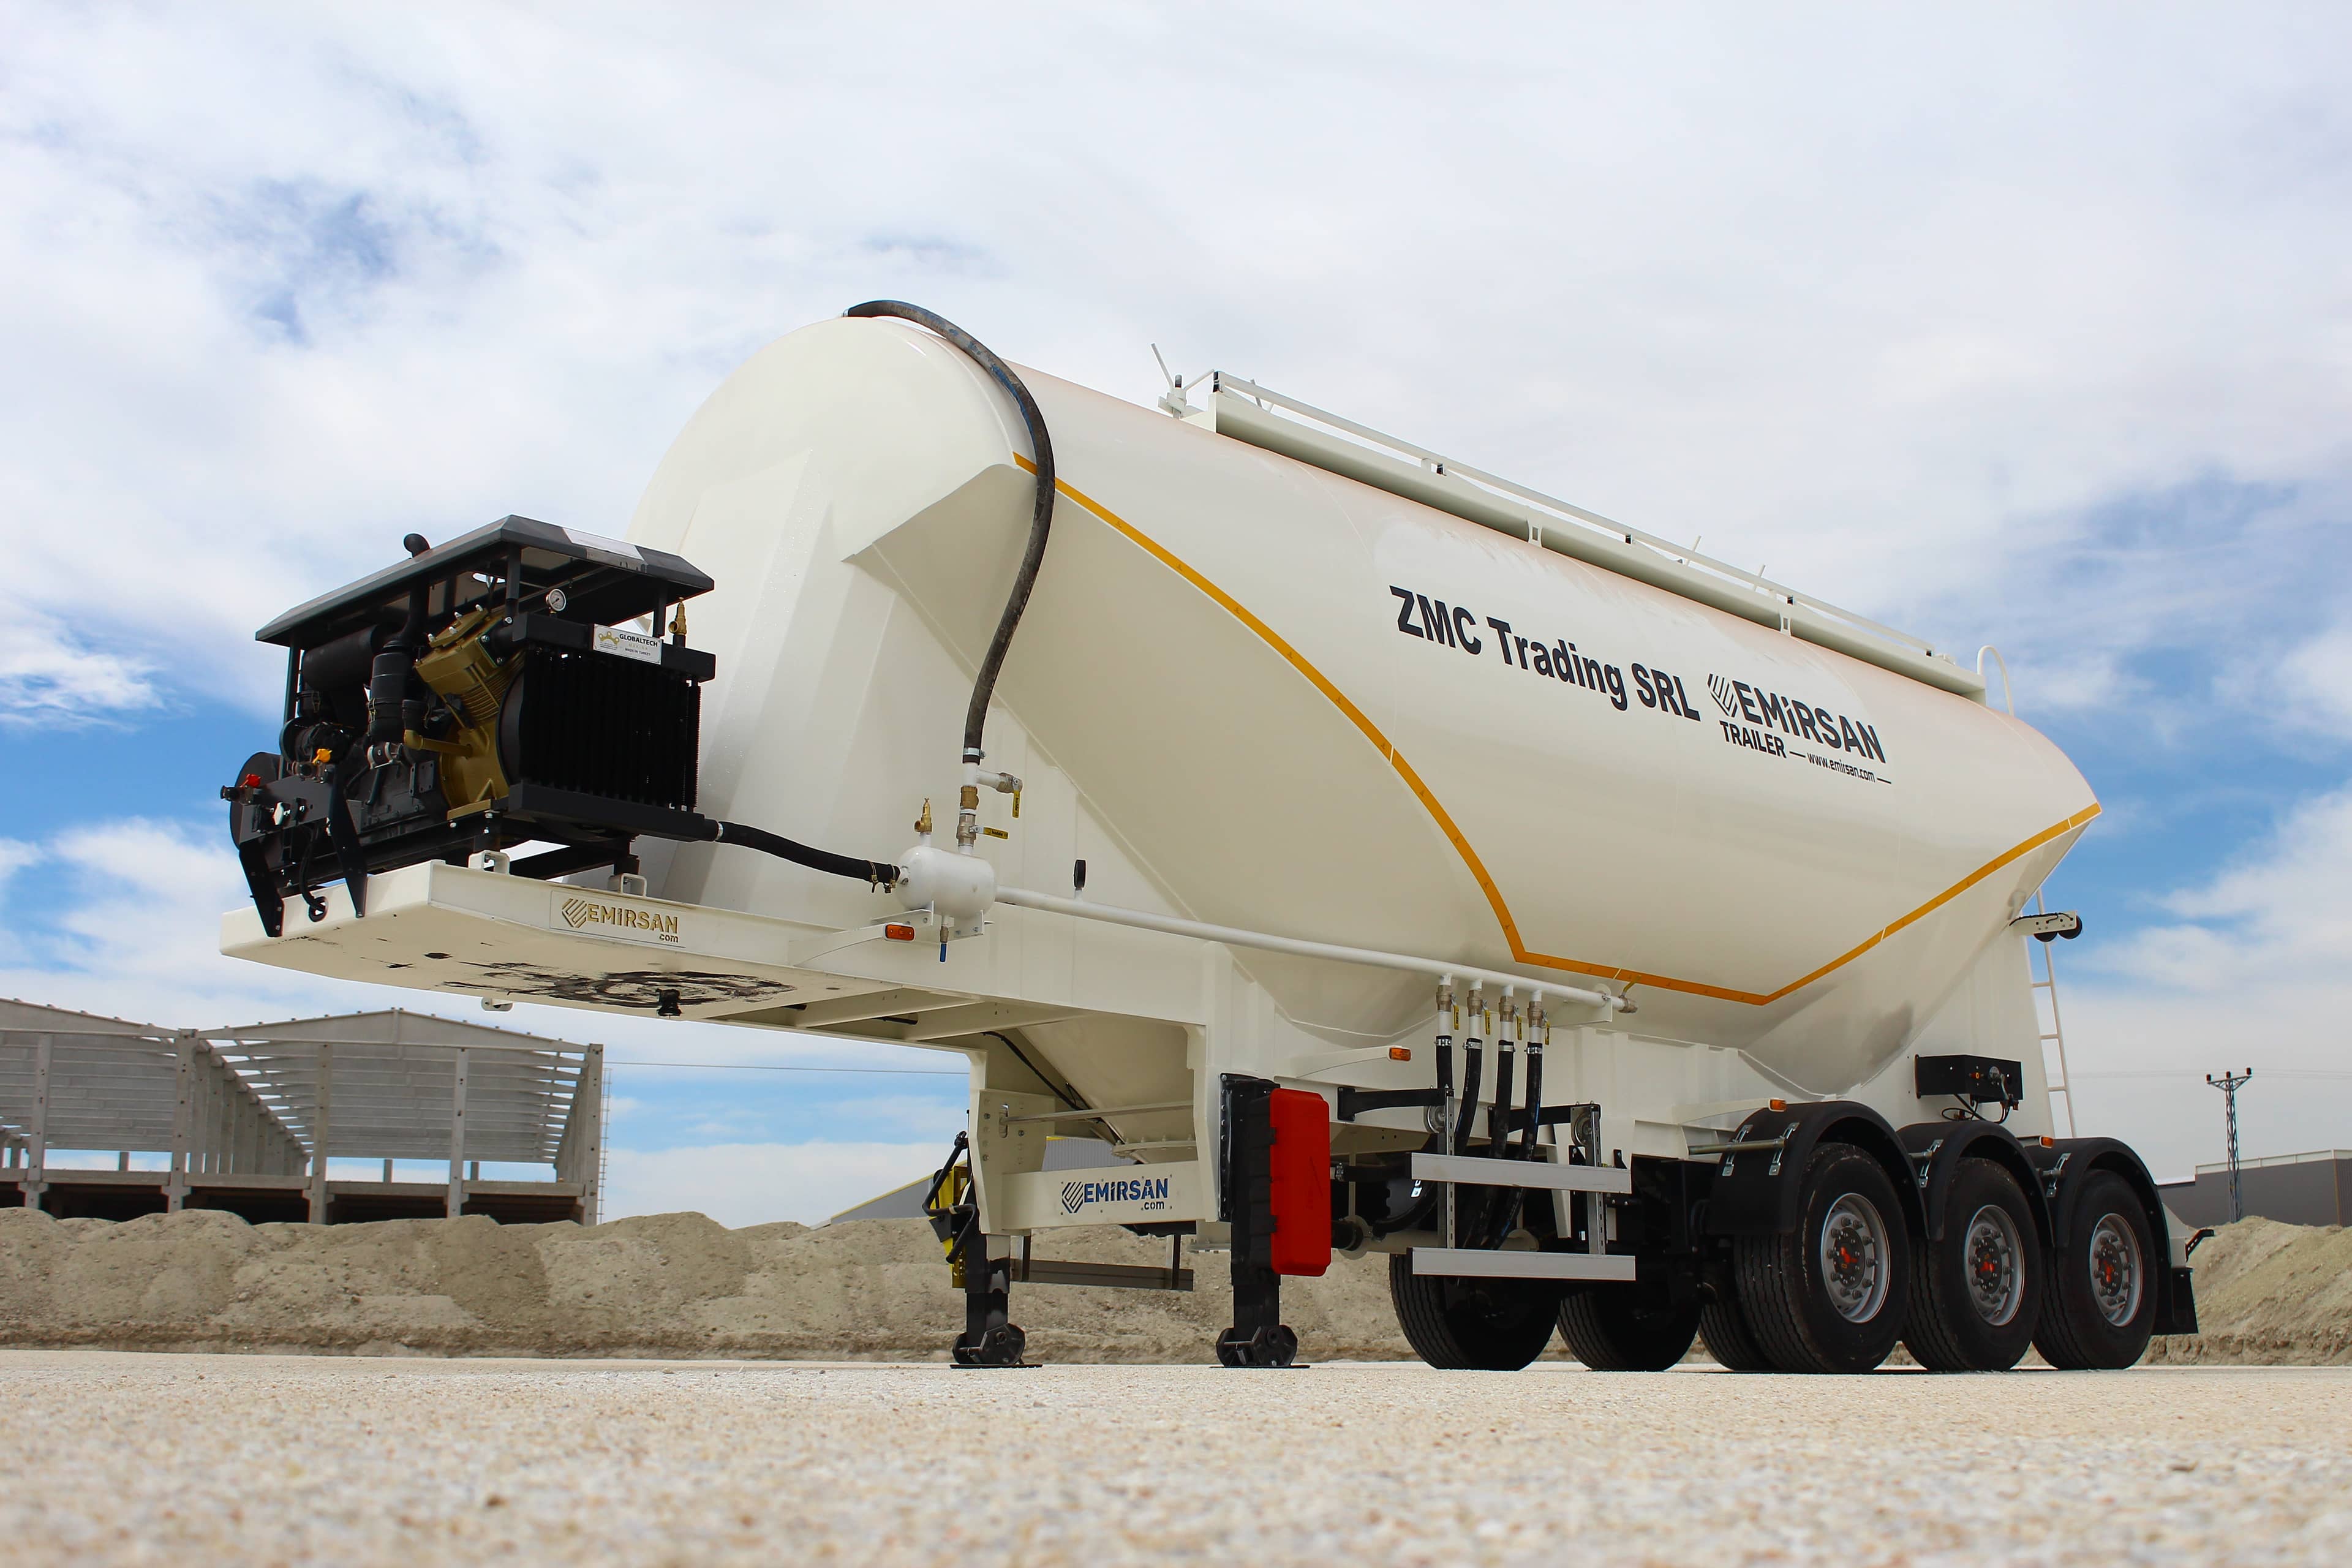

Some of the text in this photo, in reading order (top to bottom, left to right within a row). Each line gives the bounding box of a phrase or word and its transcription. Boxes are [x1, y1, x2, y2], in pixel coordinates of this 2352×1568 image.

[619, 633, 658, 647] GLOBALTECH
[1389, 585, 1701, 722] ZMC Trading SRL
[1719, 720, 1875, 783] TRAILER www.emirsan.com
